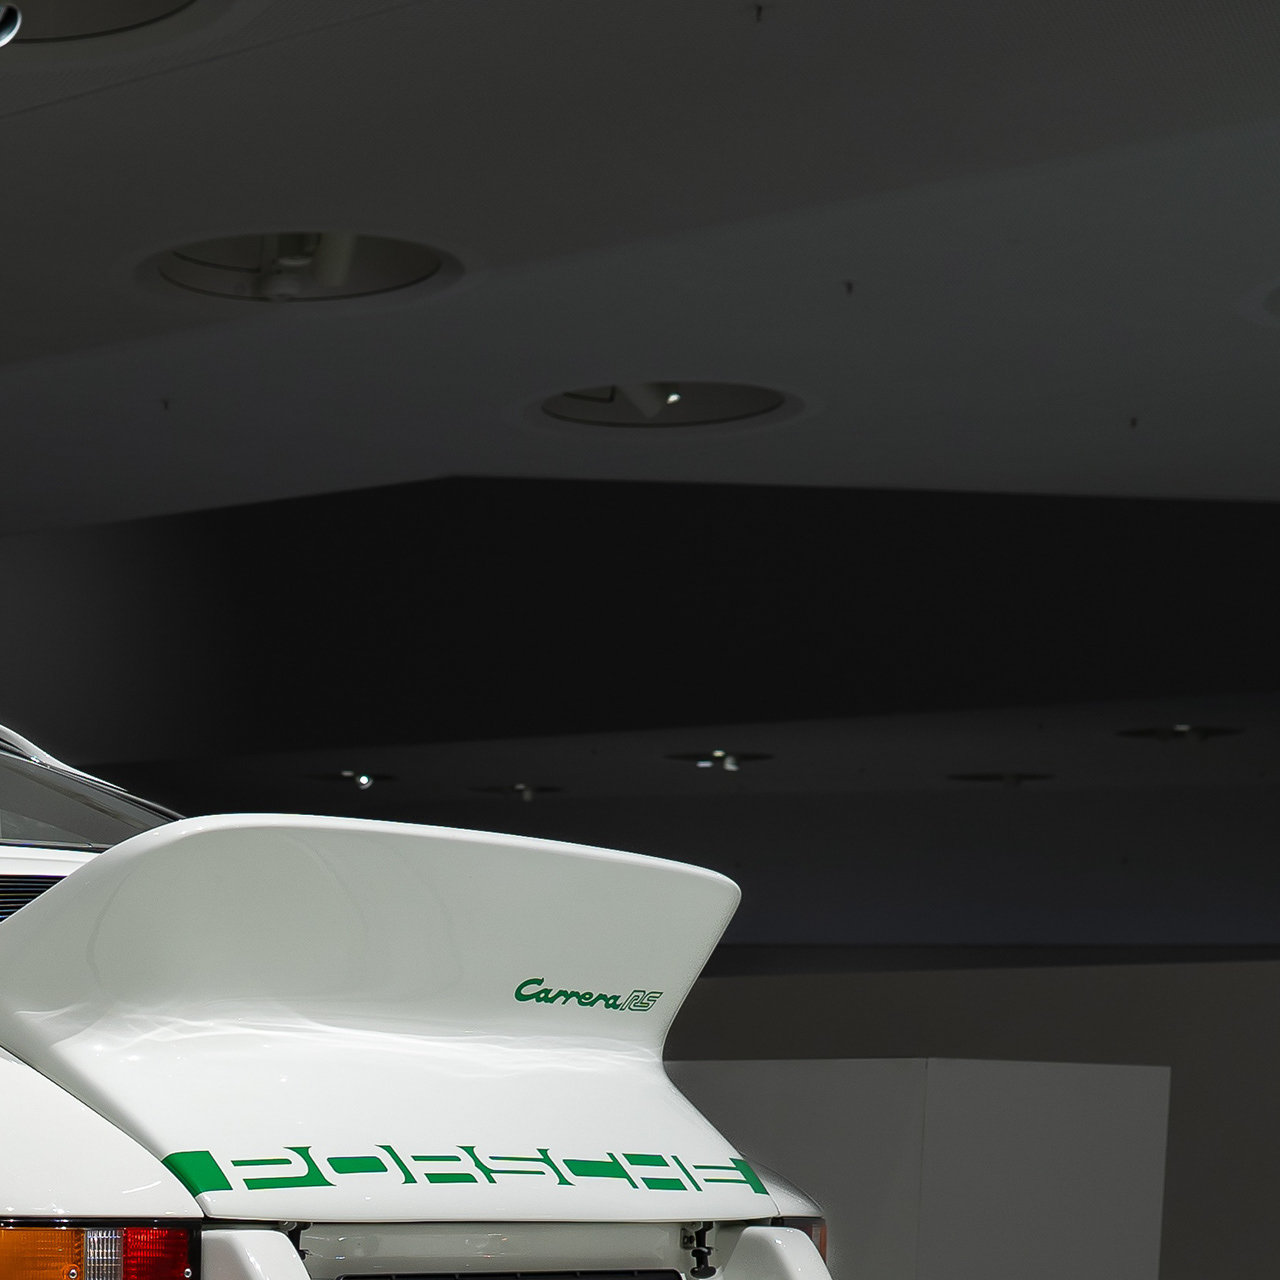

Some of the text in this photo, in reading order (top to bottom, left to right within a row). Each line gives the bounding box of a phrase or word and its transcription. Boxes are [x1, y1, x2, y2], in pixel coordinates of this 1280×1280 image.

[514, 977, 664, 1012] Carrera RS
[211, 1145, 754, 1192] PORSCHE
